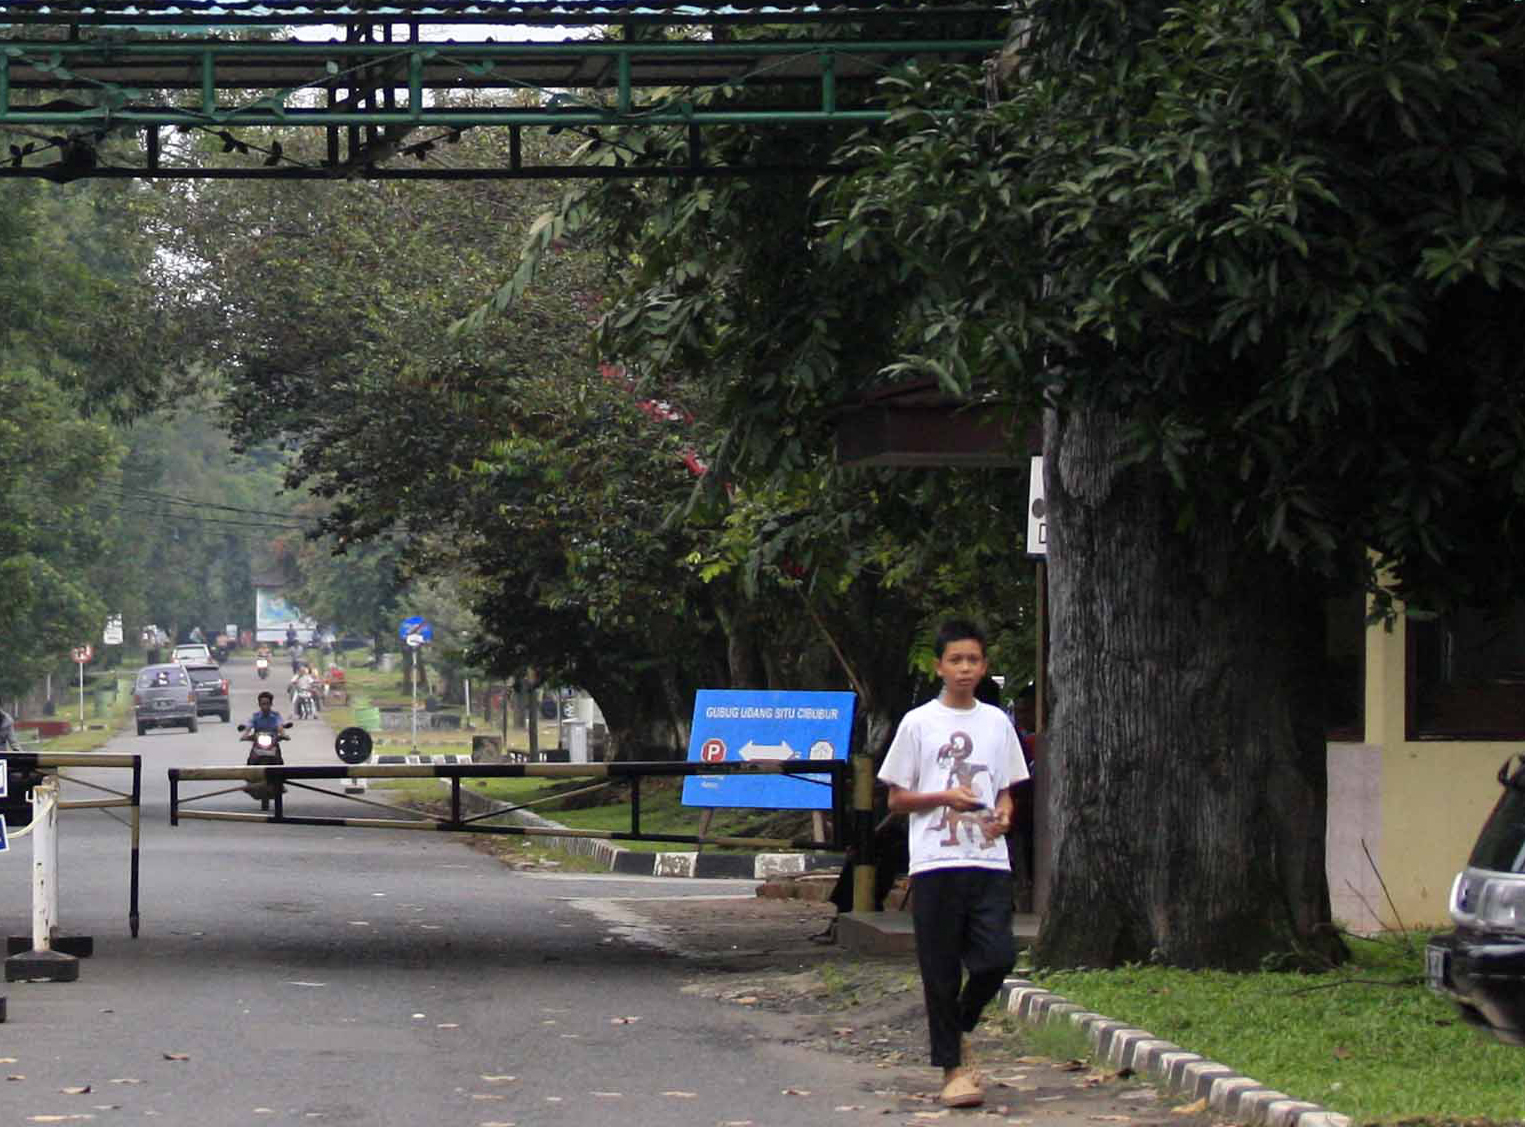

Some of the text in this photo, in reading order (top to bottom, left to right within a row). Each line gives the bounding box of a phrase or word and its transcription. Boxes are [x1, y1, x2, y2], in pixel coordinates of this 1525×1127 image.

[775, 706, 796, 720] SITU
[796, 707, 839, 721] CIBUBUR
[707, 746, 721, 761] P
